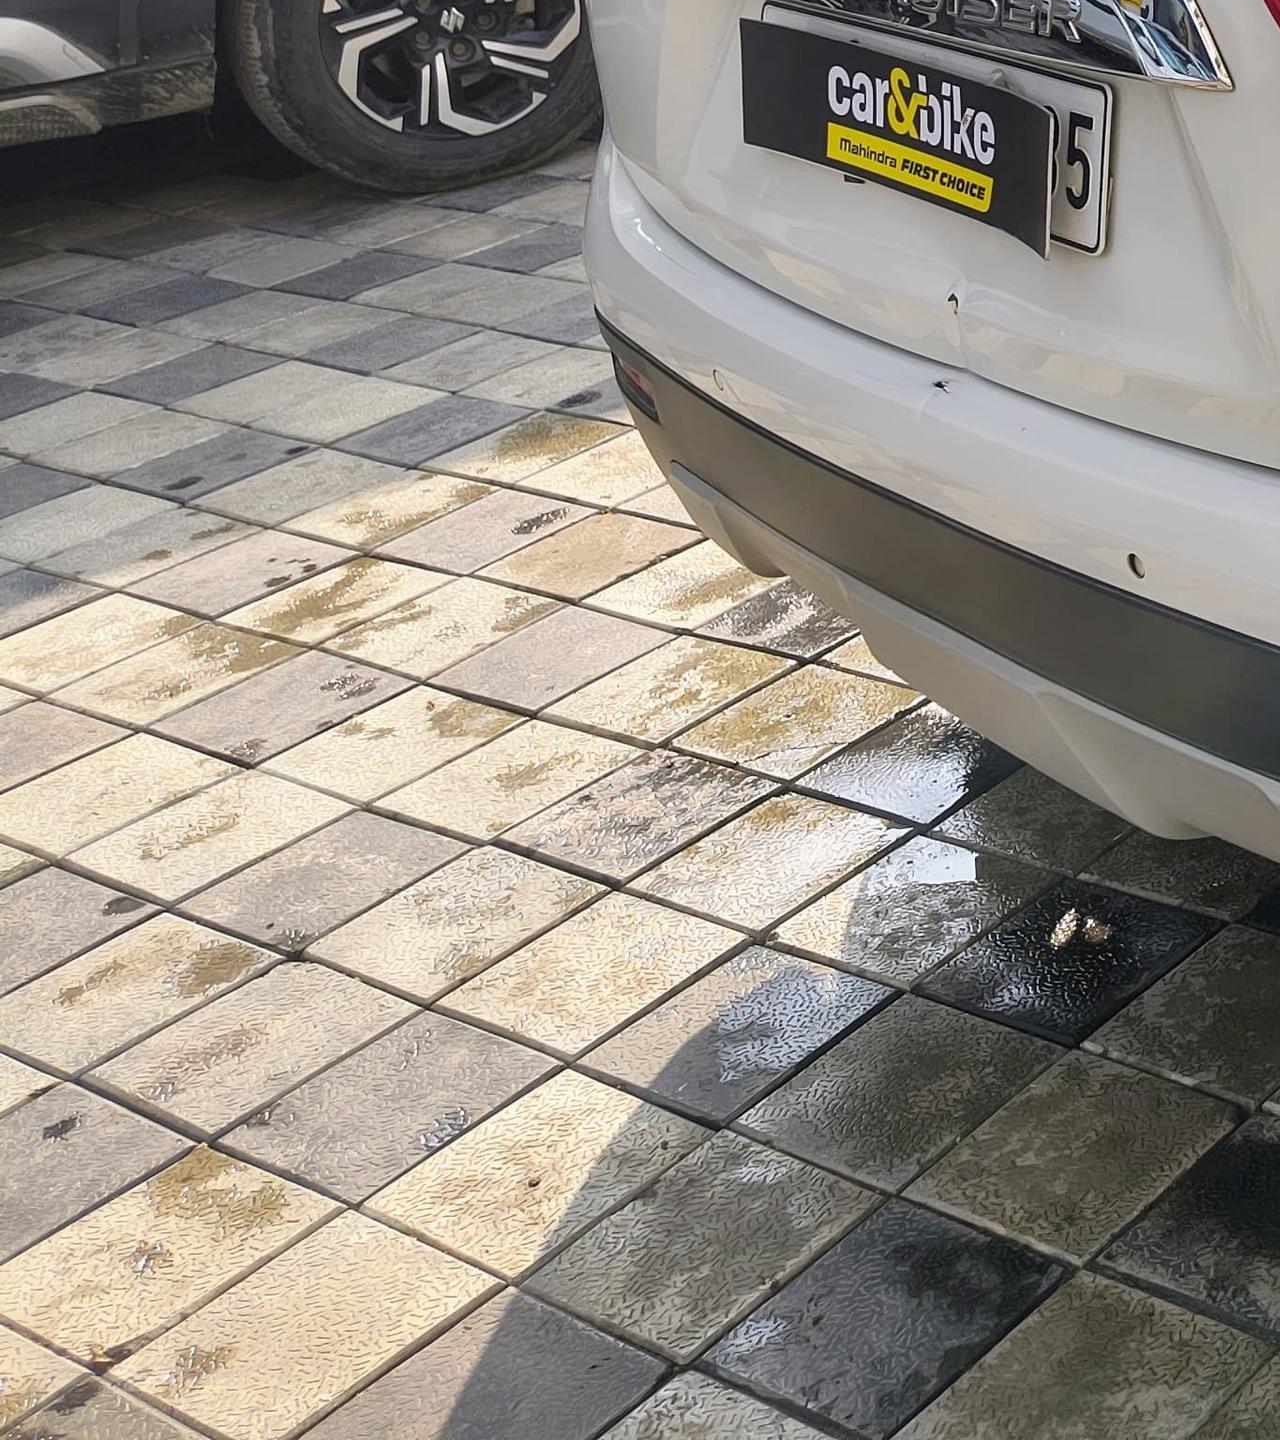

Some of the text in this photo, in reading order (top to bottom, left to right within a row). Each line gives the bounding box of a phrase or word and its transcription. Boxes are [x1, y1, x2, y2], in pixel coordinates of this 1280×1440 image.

[828, 65, 995, 165] car&bike
[900, 158, 939, 185] FIRST
[939, 172, 986, 200] CHOICE
